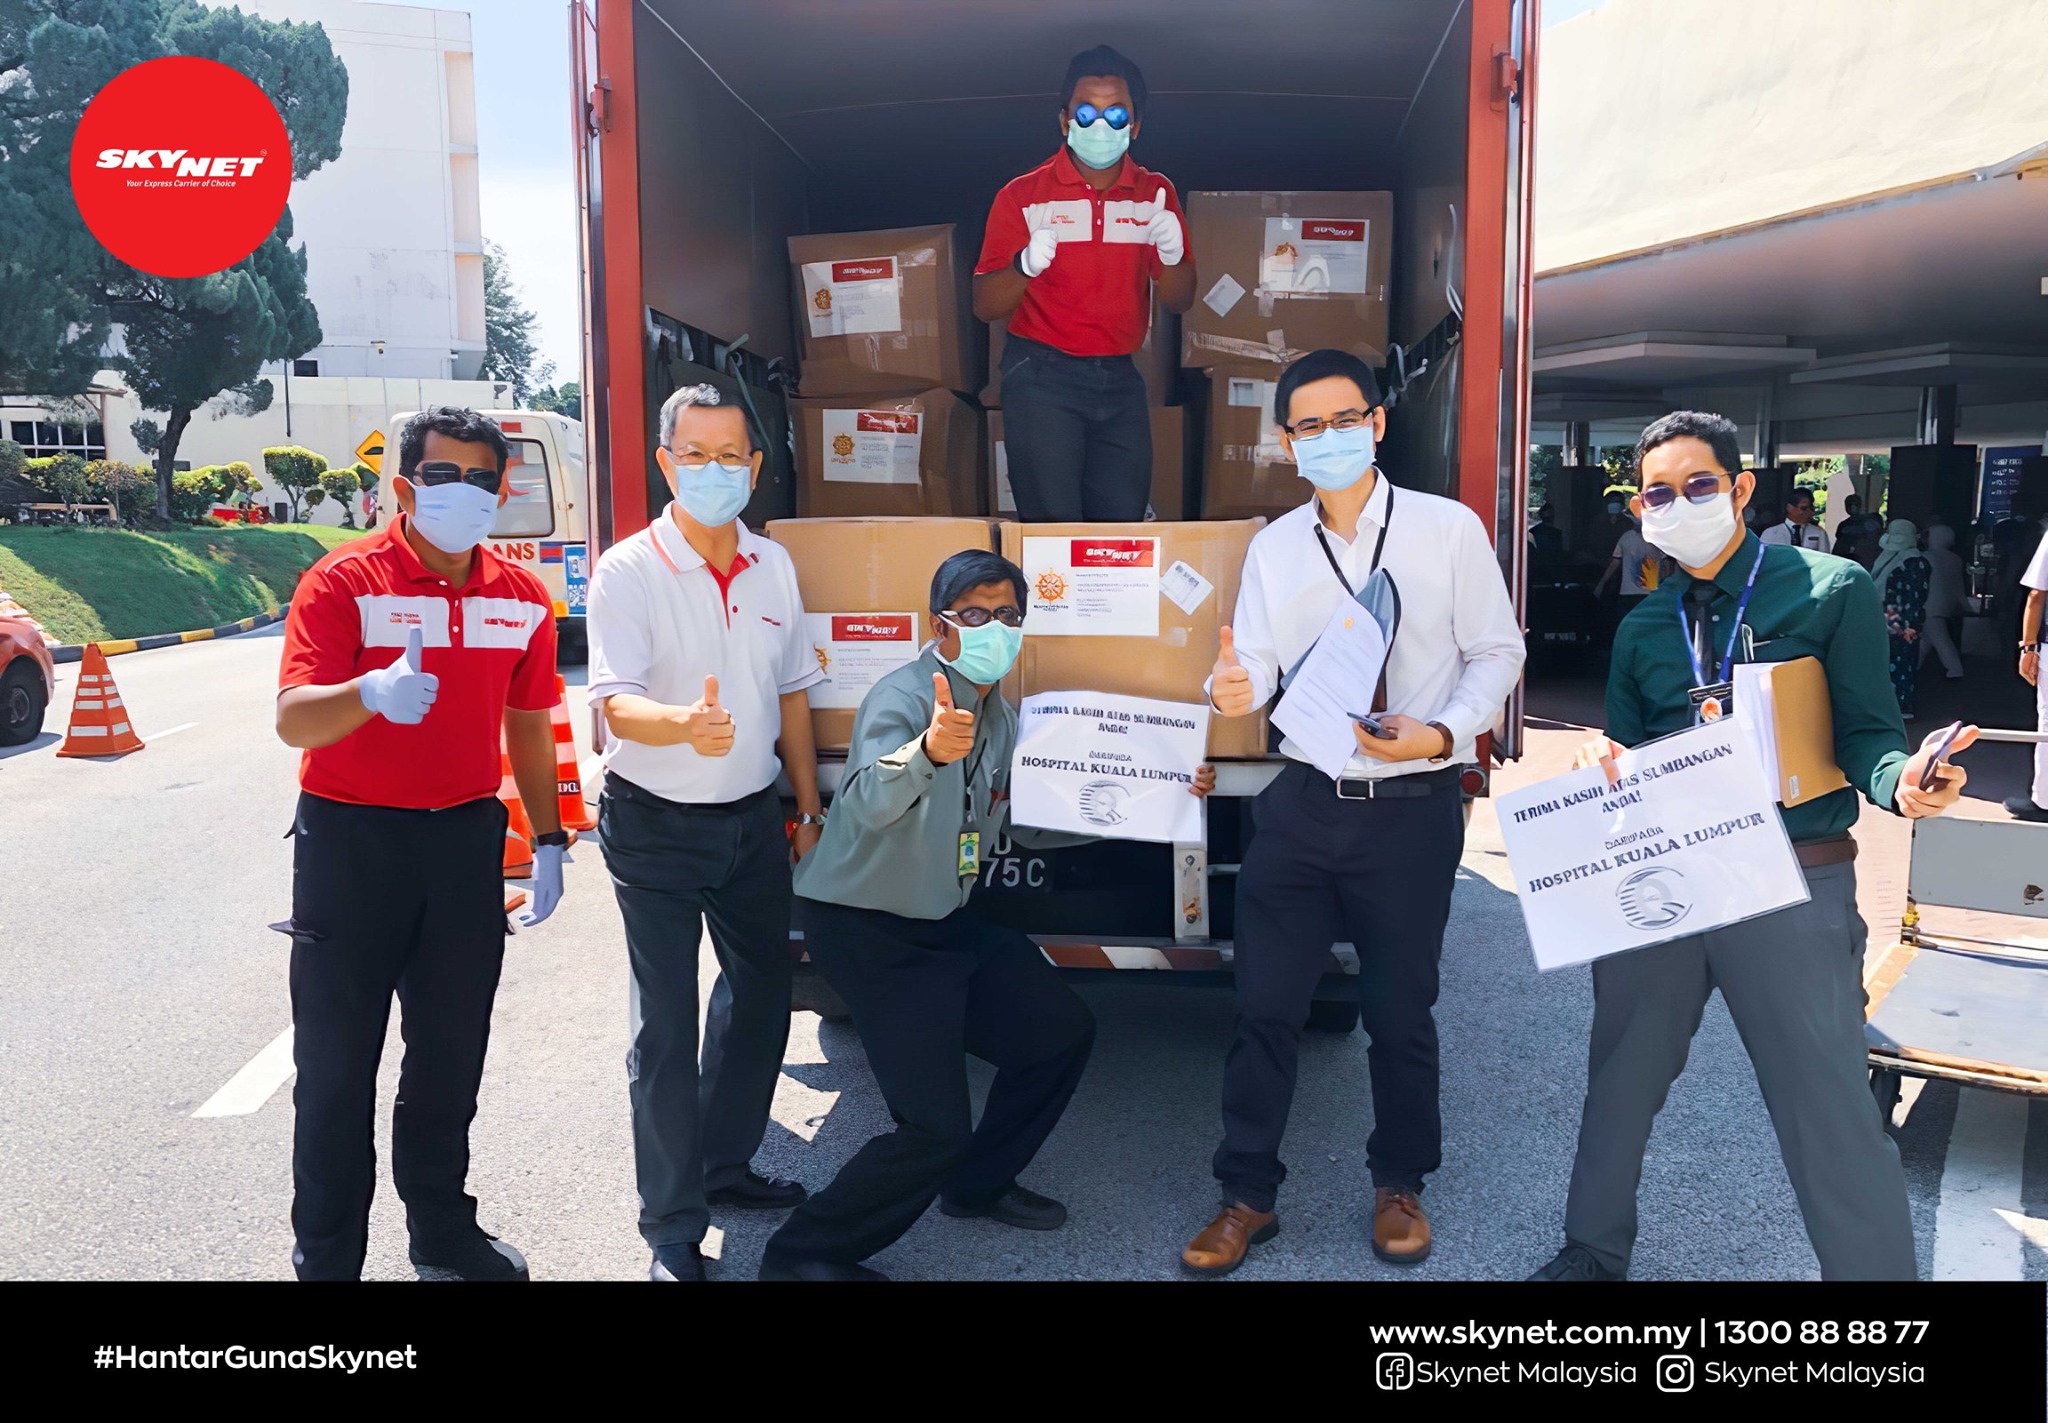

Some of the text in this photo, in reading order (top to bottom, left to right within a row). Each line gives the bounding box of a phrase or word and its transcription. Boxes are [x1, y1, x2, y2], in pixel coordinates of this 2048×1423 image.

[1021, 756, 1194, 784] HOSPITAL KUALA LUMPUR
[1513, 800, 1561, 823] TERIMA
[1562, 786, 1604, 808] KASIH
[1642, 743, 1733, 782] SUMBANGAN
[1529, 812, 1765, 893] HOSPITAL KUALA LUMPUR
